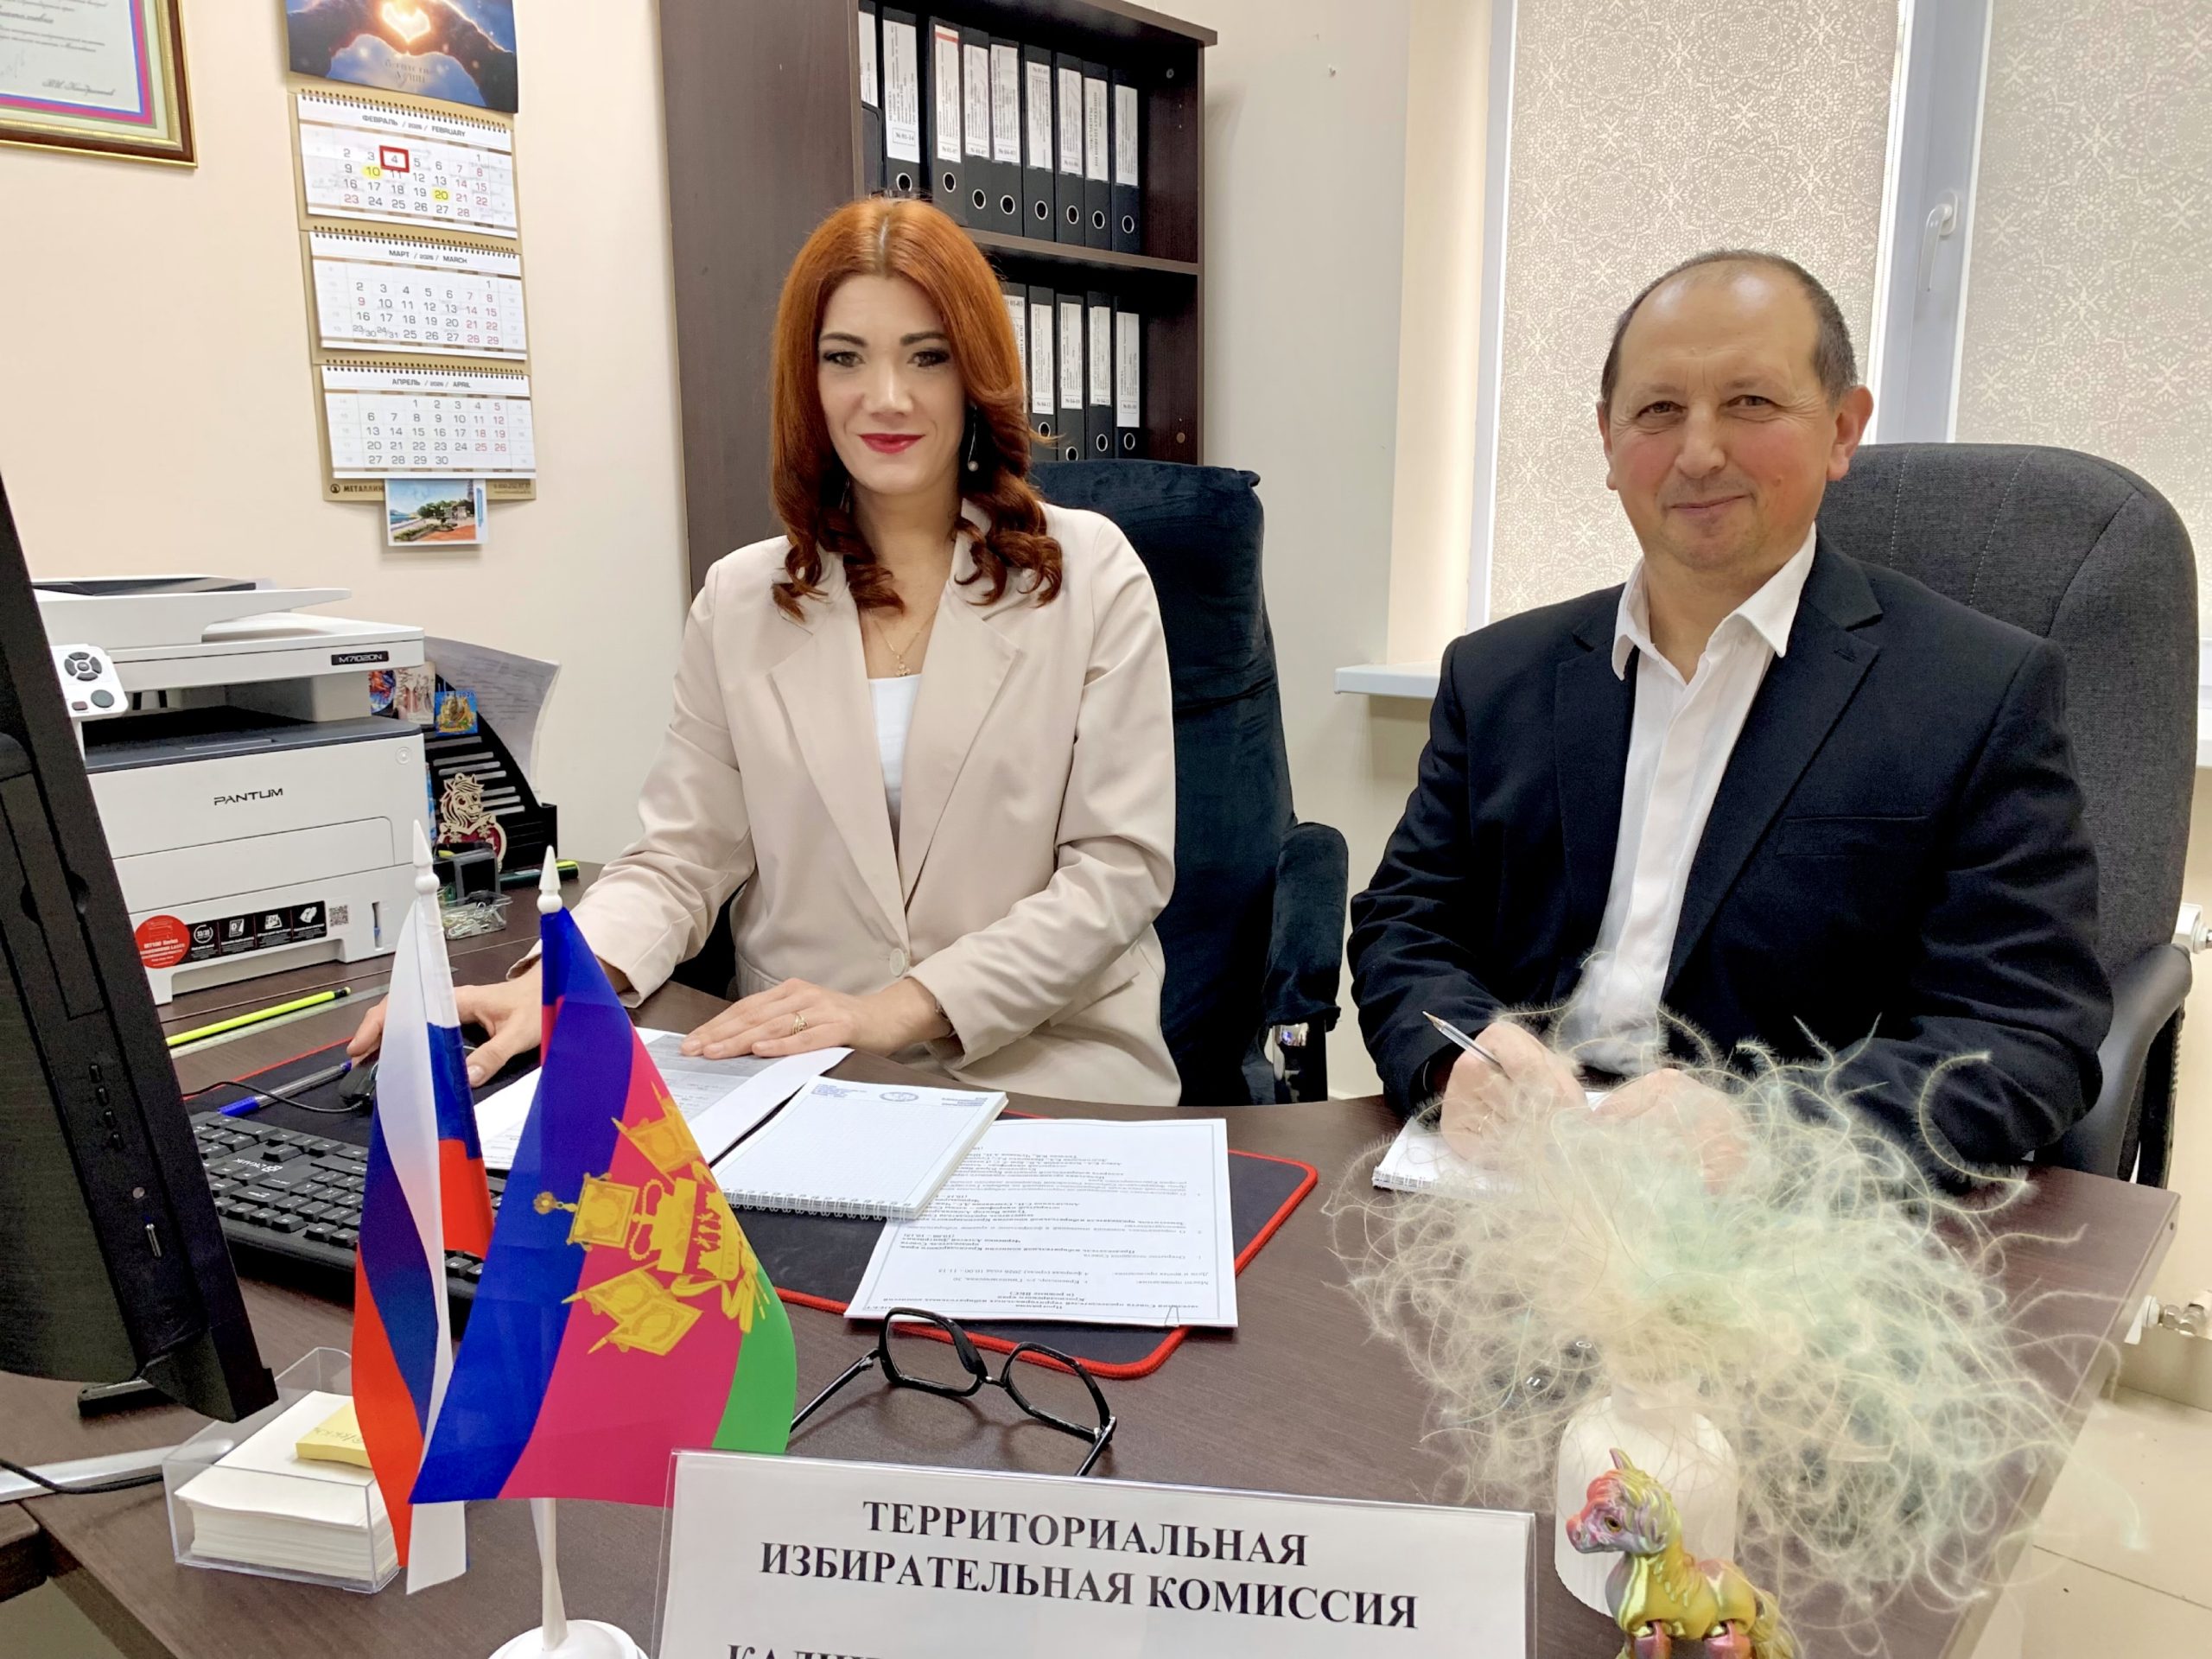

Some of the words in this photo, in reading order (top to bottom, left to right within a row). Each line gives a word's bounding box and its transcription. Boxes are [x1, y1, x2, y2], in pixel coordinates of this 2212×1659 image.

[362, 115, 398, 126] ФЕВРАЛЬ
[432, 125, 466, 137] FEBRUARY
[365, 166, 381, 177] 10
[412, 172, 425, 183] 12
[434, 175, 448, 187] 13
[455, 176, 467, 188] 14
[475, 182, 488, 193] 15
[343, 178, 359, 191] 16
[367, 181, 381, 192] 17
[391, 184, 405, 195] 18
[413, 187, 427, 198] 19
[434, 189, 449, 200] 20
[455, 193, 468, 203] 21
[475, 195, 488, 207] 22
[344, 193, 360, 205] 23
[367, 195, 384, 207] 24
[391, 199, 406, 210] 25
[414, 200, 429, 213] 26
[435, 204, 449, 214] 27
[456, 207, 471, 218] 28
[378, 298, 394, 310] 10
[401, 300, 414, 310] 11
[423, 302, 436, 312] 12
[445, 303, 458, 314] 13
[465, 305, 478, 315] 14
[485, 307, 498, 318] 15
[356, 311, 371, 321] 16
[379, 313, 393, 322] 17
[403, 315, 416, 325] 18
[424, 316, 438, 327] 19
[445, 317, 460, 328] 20
[466, 319, 478, 329] 21
[486, 321, 499, 332] 22
[403, 328, 417, 340] 25
[424, 331, 440, 340] 26
[446, 332, 460, 342] 27
[467, 334, 480, 344] 28
[486, 335, 499, 346] 29
[453, 414, 467, 424] 10
[474, 415, 485, 424] 11
[493, 416, 505, 425] 12
[365, 426, 380, 436] 13
[390, 427, 404, 436] 14
[412, 427, 426, 437] 15
[433, 428, 447, 437] 16
[454, 428, 467, 437] 17
[474, 429, 486, 438] 18
[494, 429, 506, 439] 19
[366, 441, 383, 450] 20
[390, 441, 404, 451] 21
[412, 441, 426, 451] 22
[434, 442, 448, 451] 23
[454, 442, 468, 452] 24
[474, 442, 488, 452] 25
[494, 442, 507, 453] 26
[368, 454, 383, 465] 27
[391, 454, 406, 465] 28
[413, 455, 428, 465] 29
[435, 455, 449, 466] 30
[214, 788, 283, 805] PANTUM
[862, 1501, 1308, 1567] ТЕРРИТОРИАЛЬНАЯ
[760, 1541, 1135, 1605] ИЗБИРАТЕЛЬНАЯ
[1146, 1574, 1419, 1629] КОМИССИЯ
